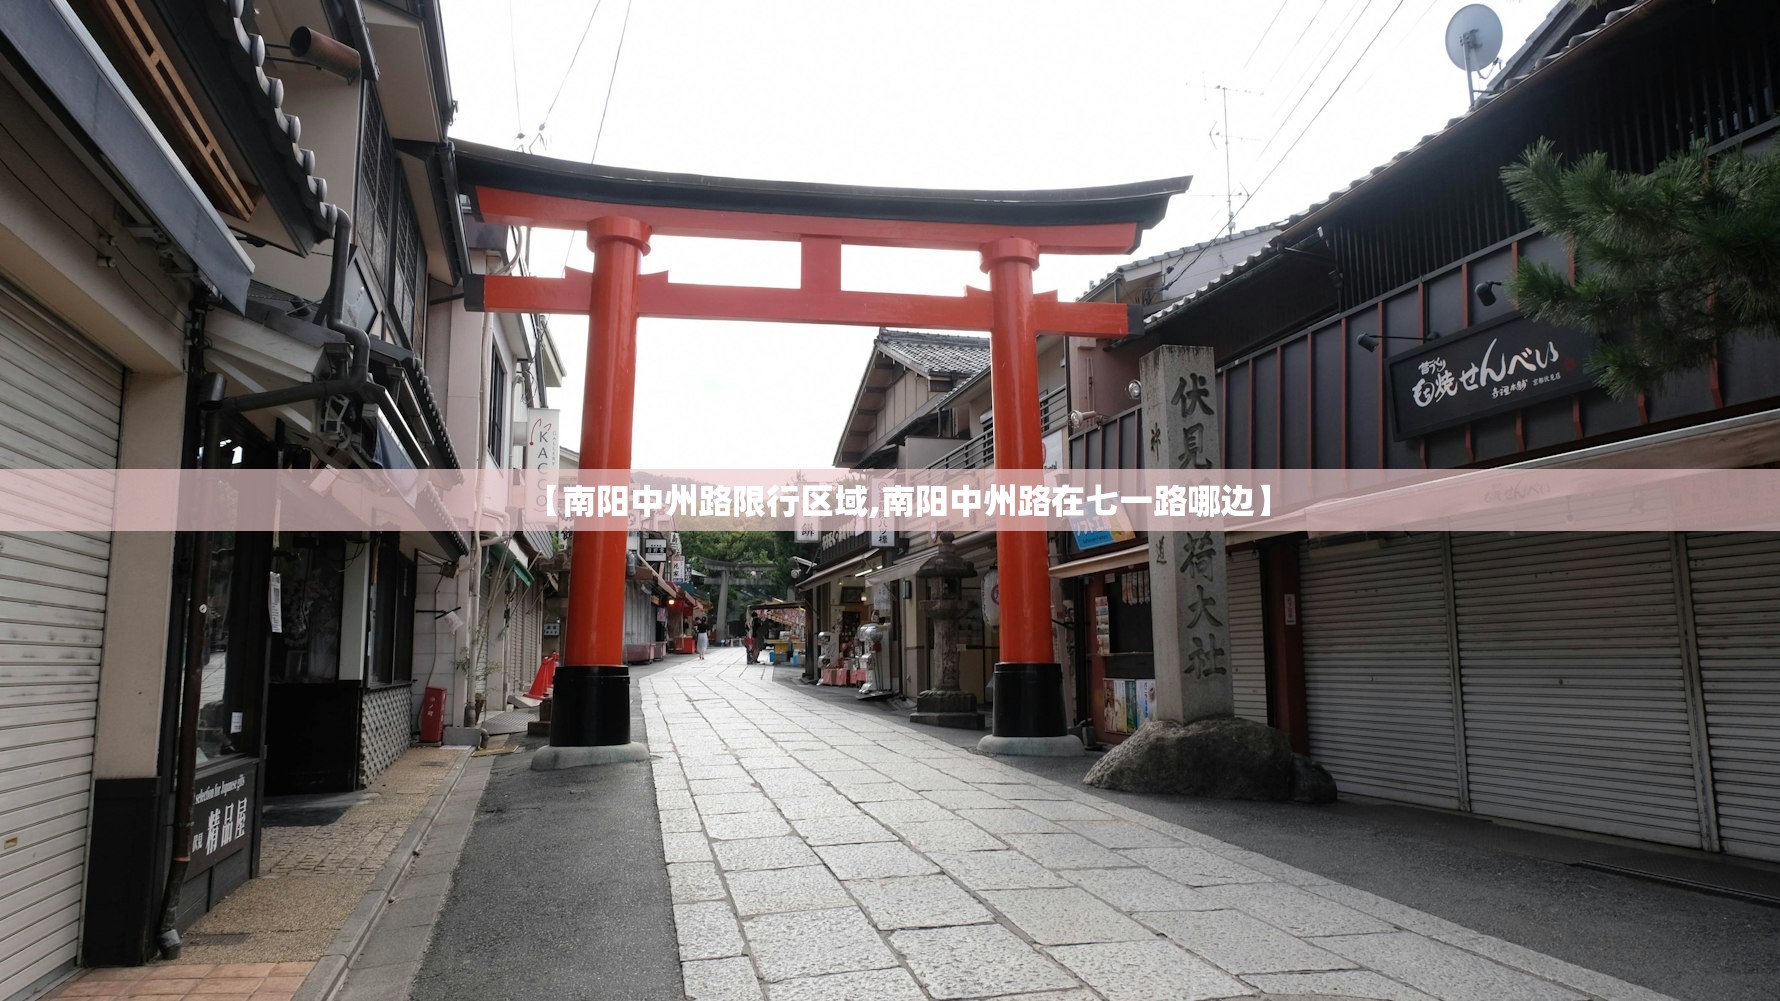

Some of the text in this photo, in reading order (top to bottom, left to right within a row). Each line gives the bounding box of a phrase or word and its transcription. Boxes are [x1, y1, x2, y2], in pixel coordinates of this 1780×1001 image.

[1171, 372, 1227, 679] 伏見荷大社
[206, 797, 248, 856] 精品屋
